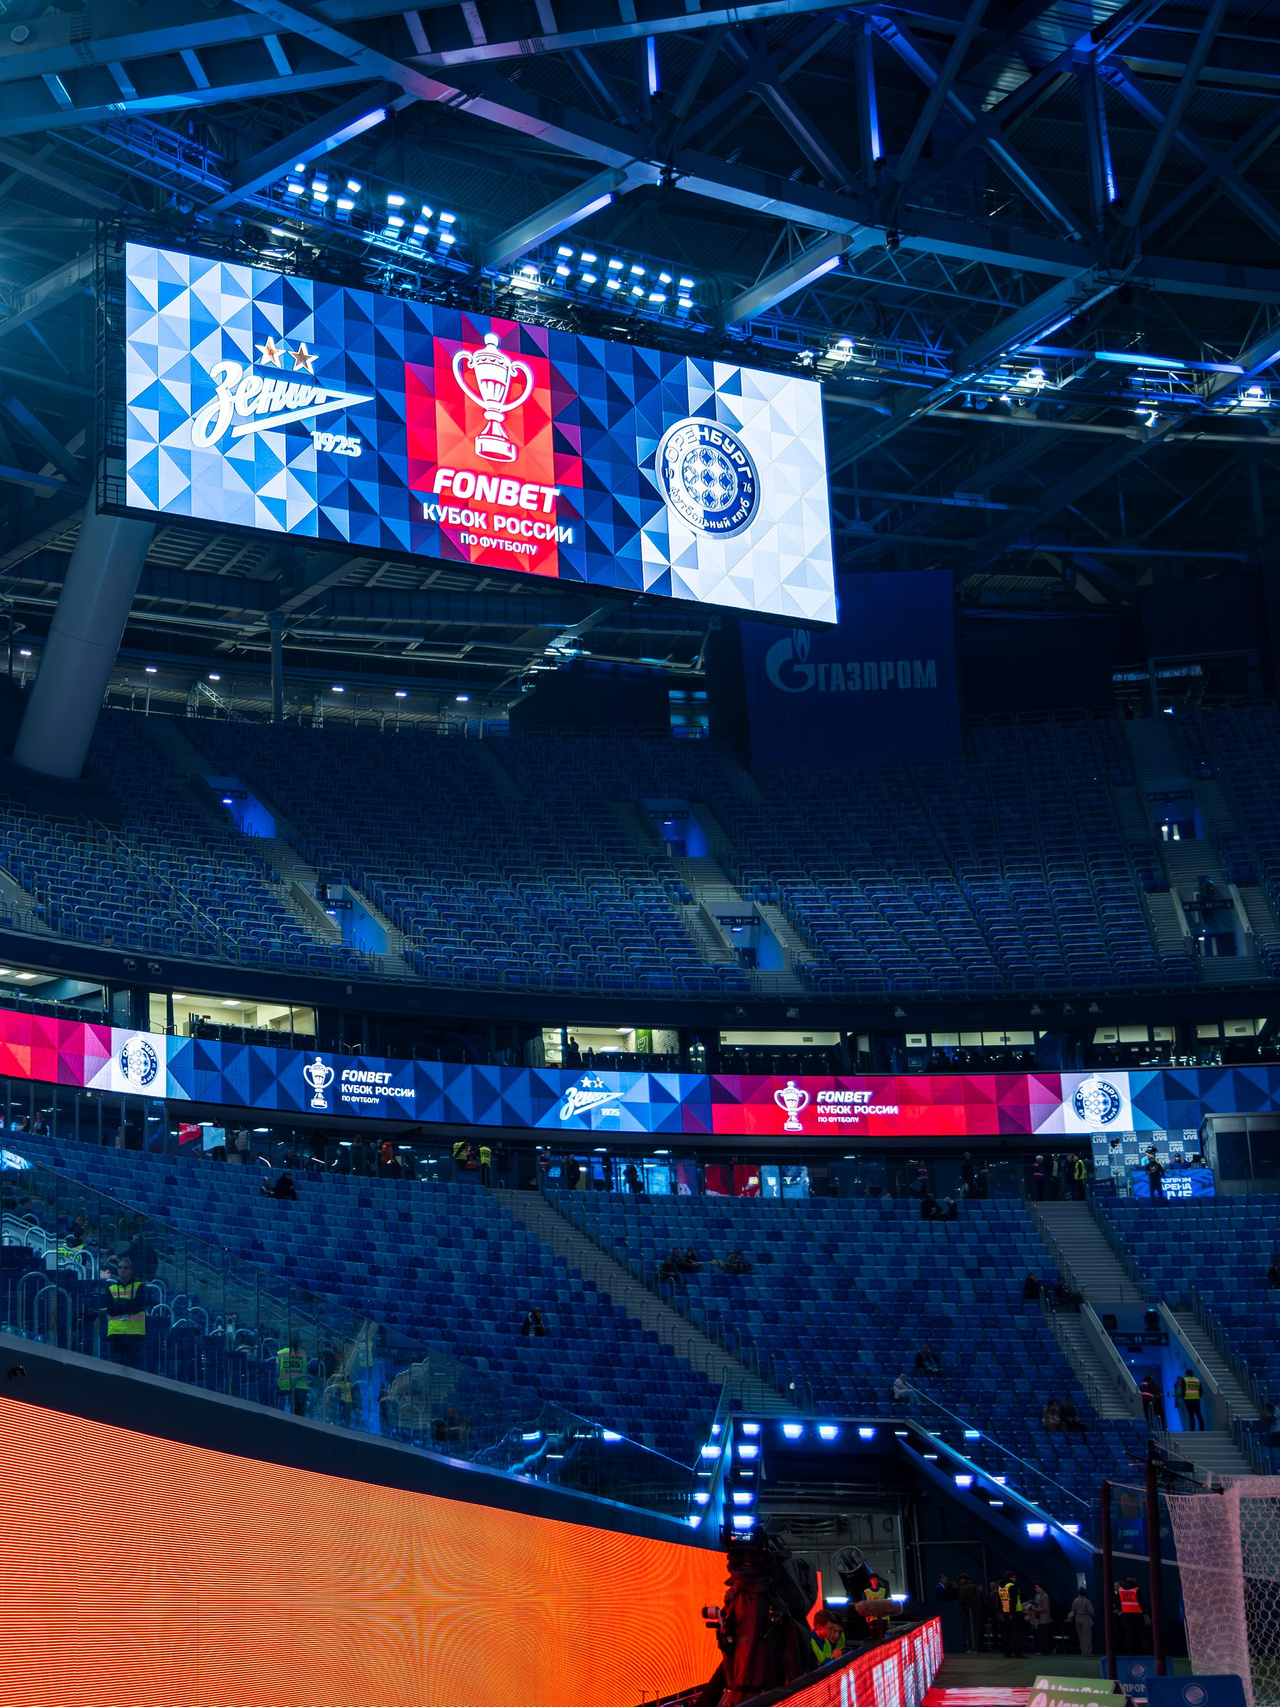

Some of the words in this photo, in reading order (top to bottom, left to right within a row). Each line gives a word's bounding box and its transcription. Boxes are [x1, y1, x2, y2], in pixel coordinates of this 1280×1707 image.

[191, 361, 375, 448] Зенит
[311, 431, 362, 457] 1925
[665, 426, 752, 479] ОРЕНБУРГ
[433, 469, 560, 513] FONBET
[742, 482, 752, 493] 76
[733, 497, 750, 524] клуб
[423, 502, 487, 529] КУБОК
[493, 515, 573, 544] РОССИИ
[460, 533, 478, 546] ПО
[479, 537, 537, 556] ФУТБОЛУ
[817, 659, 937, 692] ГАЗПРОМ
[341, 1070, 392, 1084] FONBET
[341, 1083, 373, 1095] КУБОК
[375, 1086, 415, 1098] РОССИИ
[816, 1091, 872, 1103] FONBET
[816, 1105, 851, 1114] КУБОК
[854, 1105, 899, 1115] РОССИИ
[1166, 1190, 1193, 1199] IVE
